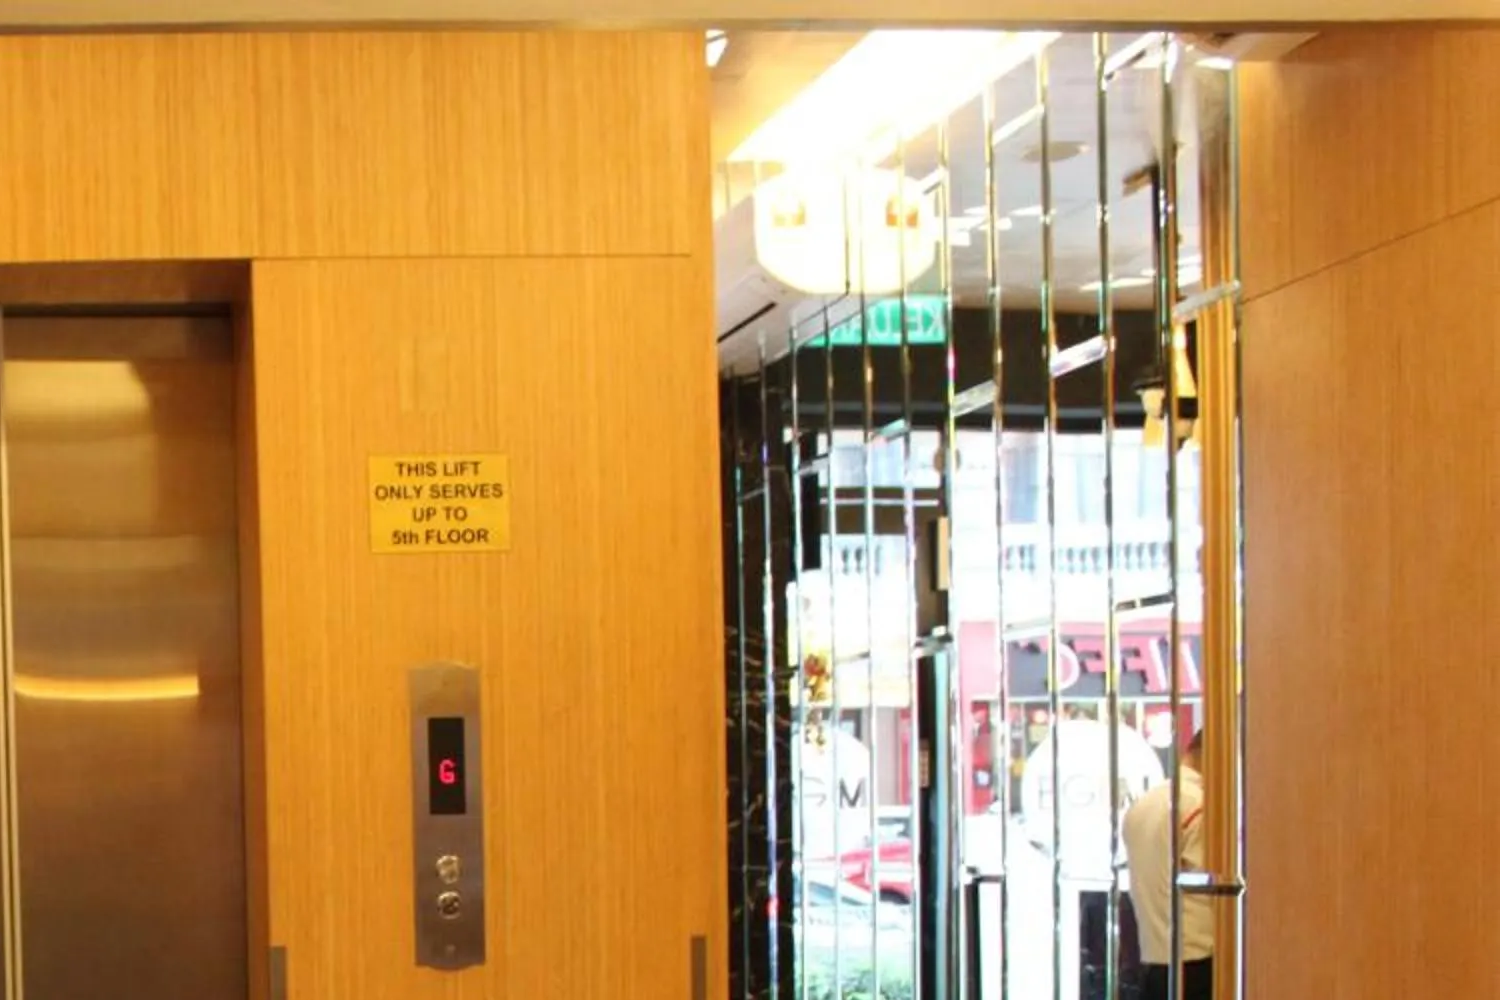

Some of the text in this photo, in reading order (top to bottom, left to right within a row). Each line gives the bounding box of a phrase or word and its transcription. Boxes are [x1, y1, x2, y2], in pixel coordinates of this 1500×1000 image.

[394, 460, 481, 477] THIS LIFT
[375, 483, 504, 500] ONLY SERVES
[412, 506, 468, 523] UP TO
[392, 528, 490, 545] 5th FLOOR
